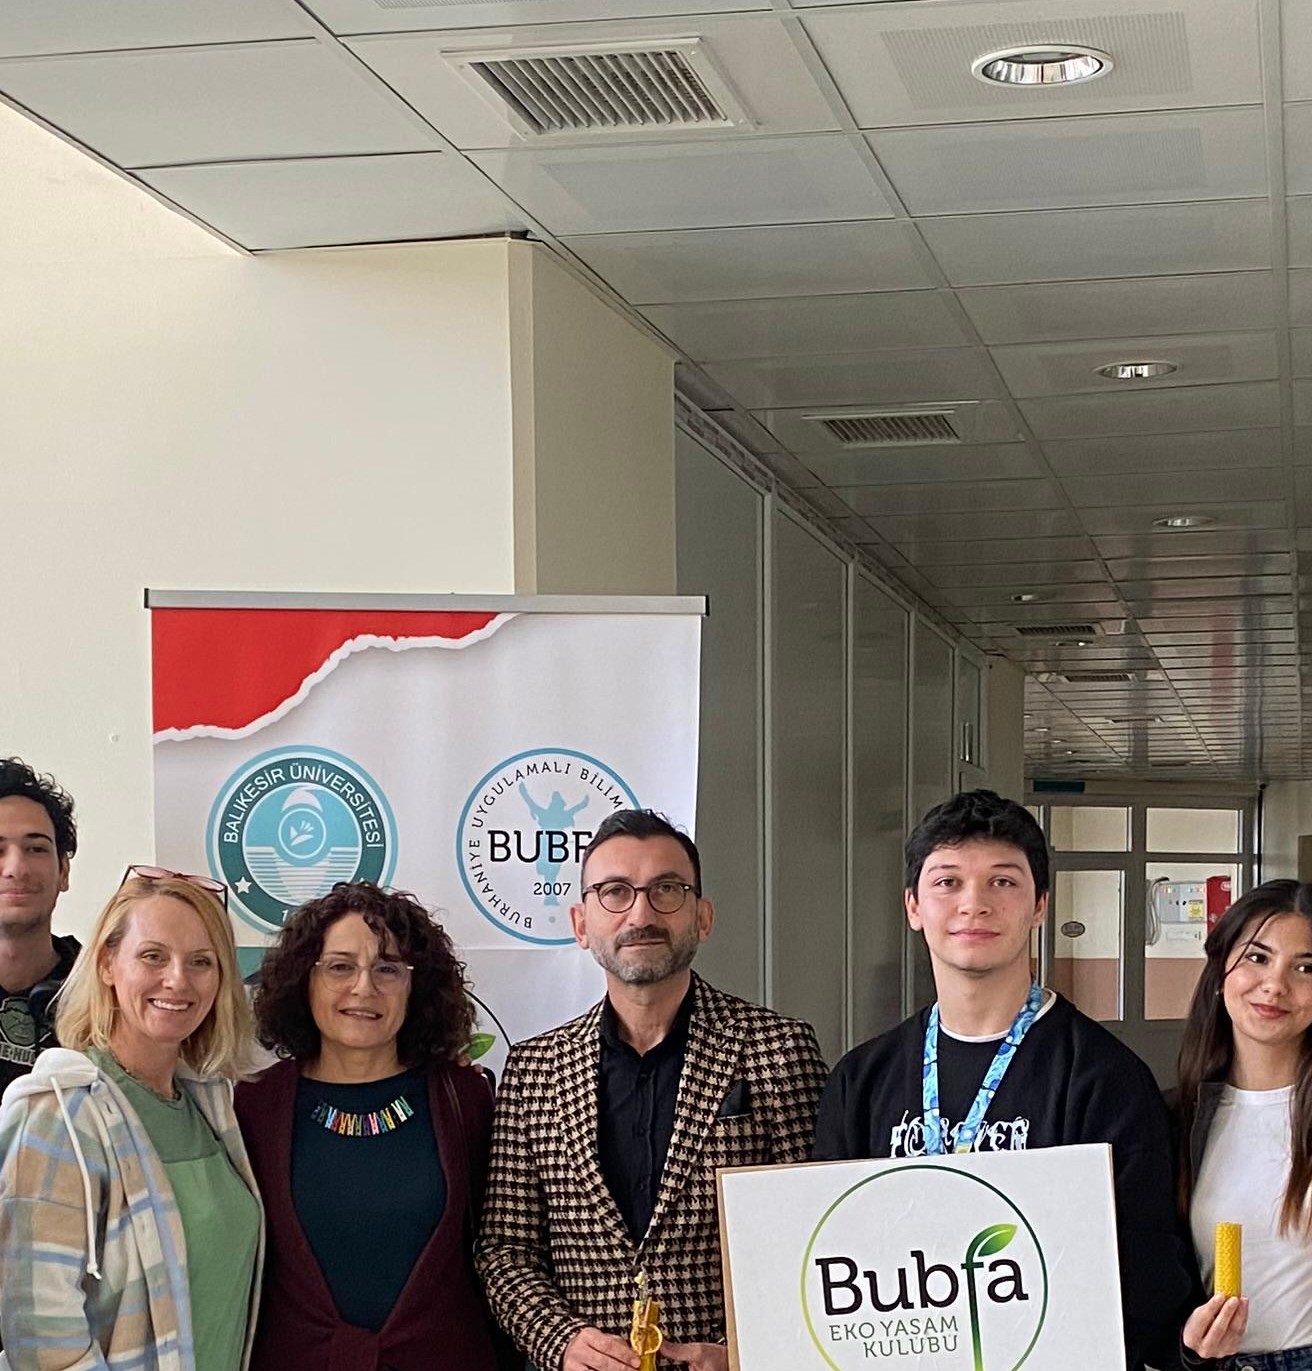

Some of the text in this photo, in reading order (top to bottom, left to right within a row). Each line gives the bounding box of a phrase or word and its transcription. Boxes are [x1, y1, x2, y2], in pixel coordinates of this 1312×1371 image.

[223, 762, 384, 848] BALIKESİR ÜNİVERSİTESİ
[469, 761, 624, 929] BURHANİYE UYGULAMALI BİLİM
[487, 829, 593, 864] BUBF
[533, 881, 572, 896] 2007
[829, 1321, 875, 1341] EKO
